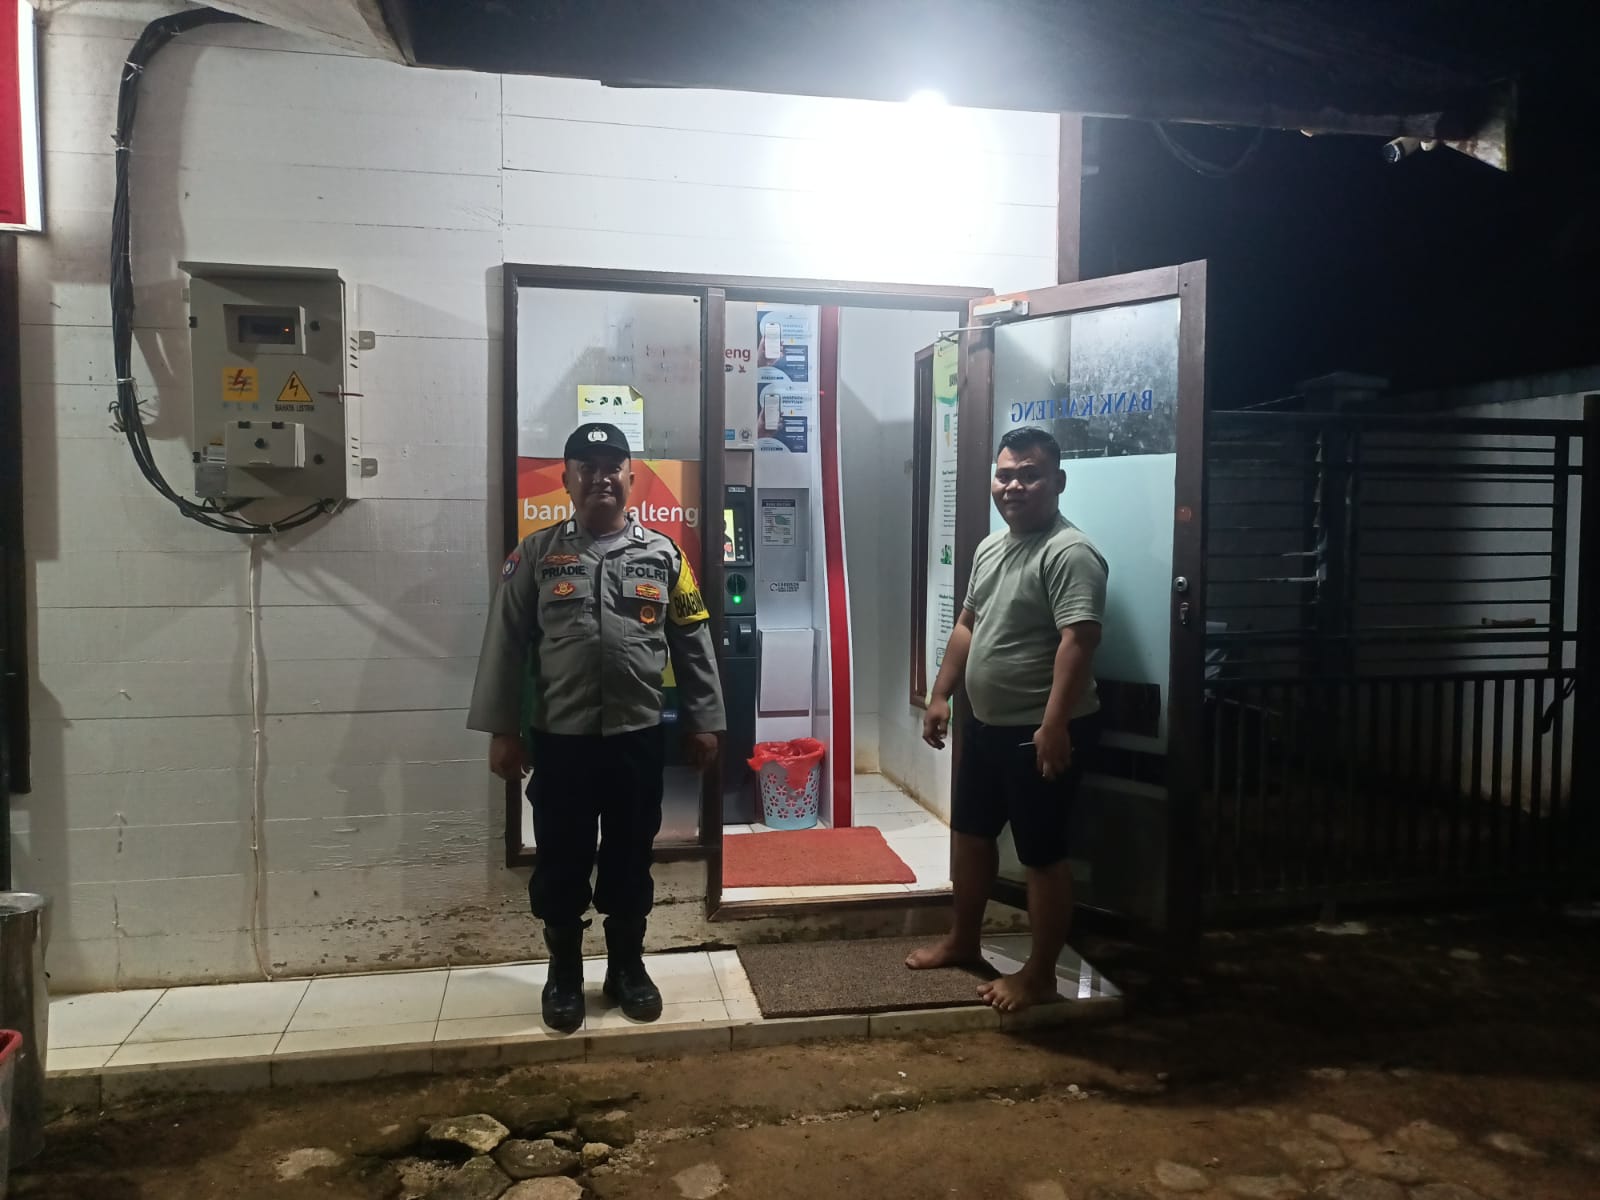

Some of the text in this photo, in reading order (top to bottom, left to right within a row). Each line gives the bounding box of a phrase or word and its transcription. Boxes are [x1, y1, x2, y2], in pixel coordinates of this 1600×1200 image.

[725, 348, 751, 362] eng
[622, 500, 699, 528] alteng
[541, 565, 586, 579] PRIADIE
[625, 565, 667, 582] POLRI
